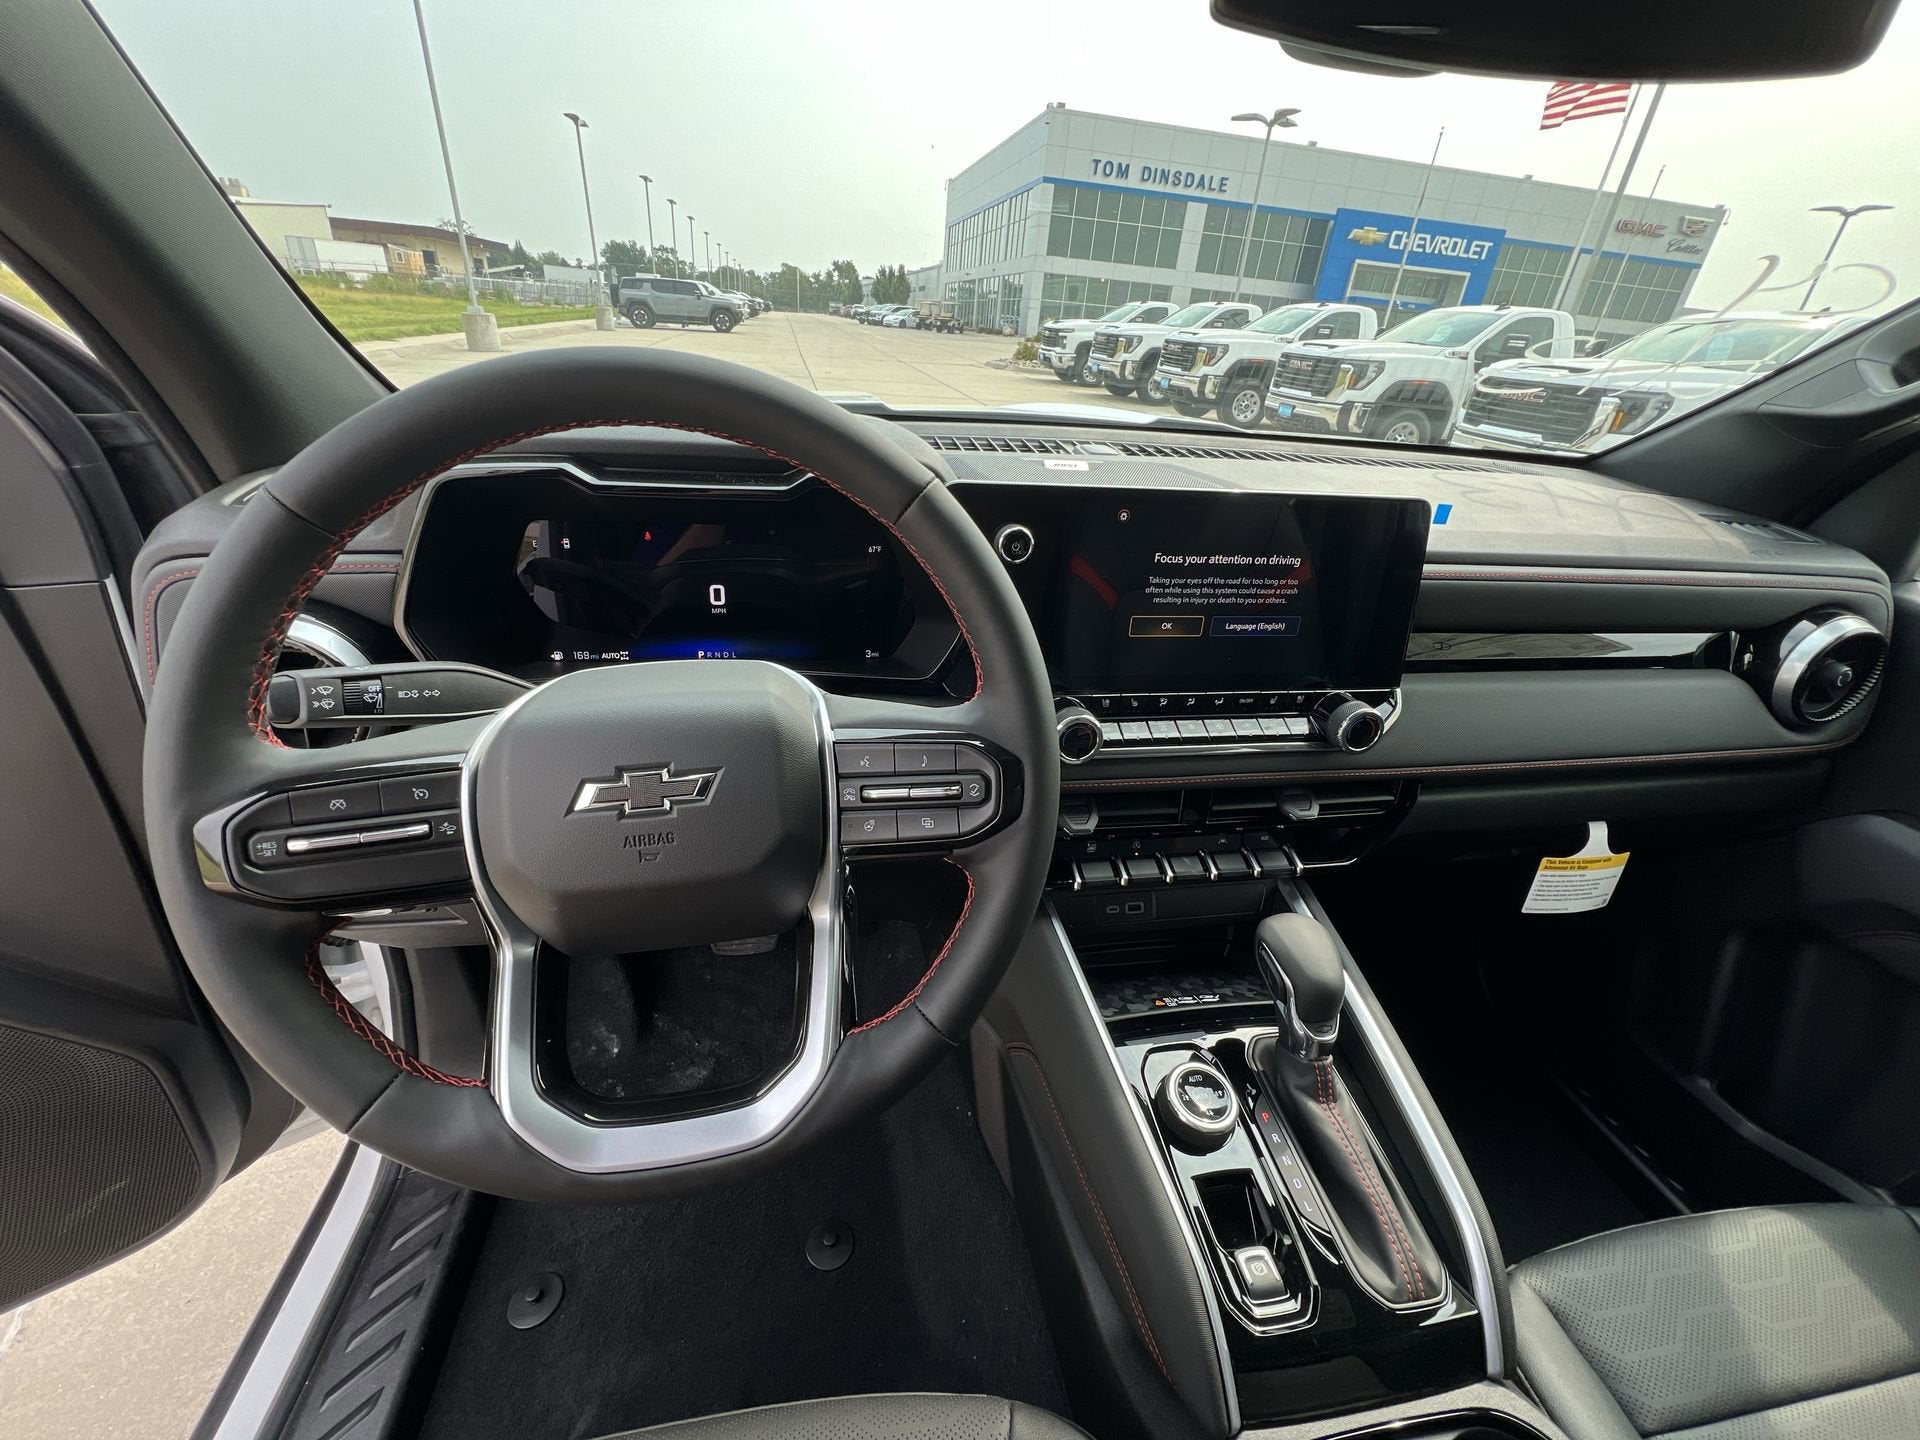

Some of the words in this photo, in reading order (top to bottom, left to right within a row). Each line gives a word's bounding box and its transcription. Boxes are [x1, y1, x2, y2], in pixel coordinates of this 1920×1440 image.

[1092, 158, 1131, 180] TOM
[1141, 165, 1230, 193] DINSDALE
[1616, 218, 1668, 238] GMC
[1388, 230, 1494, 261] CHEVROLET
[1154, 553, 1184, 564] Focus
[1184, 555, 1207, 567] your
[1208, 554, 1253, 565] attention
[1254, 557, 1267, 565] on
[1268, 555, 1301, 568] driving
[1149, 577, 1170, 585] Taking
[1170, 578, 1186, 586] your
[1203, 576, 1214, 585] off
[1214, 577, 1225, 585] the
[1226, 577, 1241, 585] road
[1241, 578, 1252, 586] for
[1264, 578, 1279, 586] long
[709, 584, 725, 605] 0
[1182, 587, 1201, 595] using
[1153, 596, 1182, 605] resulting
[1190, 596, 1208, 605] injury
[1217, 596, 1236, 604] death
[1265, 597, 1287, 605] others.
[1161, 622, 1173, 630] OK
[1225, 622, 1256, 631] Language
[1257, 622, 1286, 631] (English)
[601, 652, 620, 660] AUTO
[623, 831, 675, 849] AIRBAG
[1188, 1074, 1203, 1083] AUTO
[1261, 1112, 1269, 1123] P
[1271, 1133, 1281, 1143] R
[1282, 1155, 1292, 1166] N
[1292, 1177, 1302, 1189] D
[1303, 1200, 1313, 1212] L
